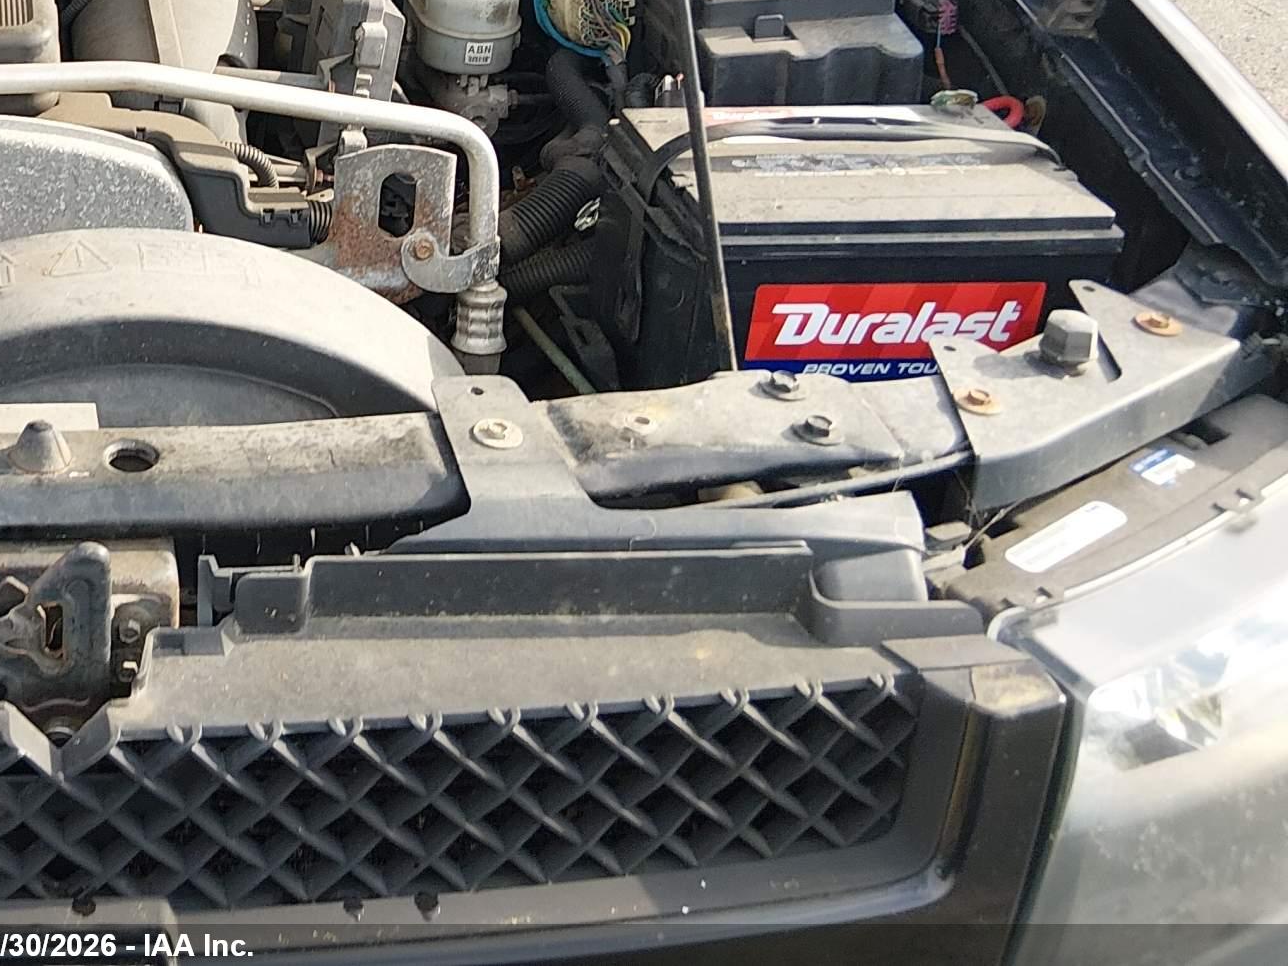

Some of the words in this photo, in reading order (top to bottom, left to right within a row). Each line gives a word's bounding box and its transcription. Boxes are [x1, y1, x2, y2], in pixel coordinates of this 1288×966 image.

[772, 300, 1020, 346] Duralast
[802, 363, 891, 376] PROVEN
[897, 362, 941, 375] TOU
